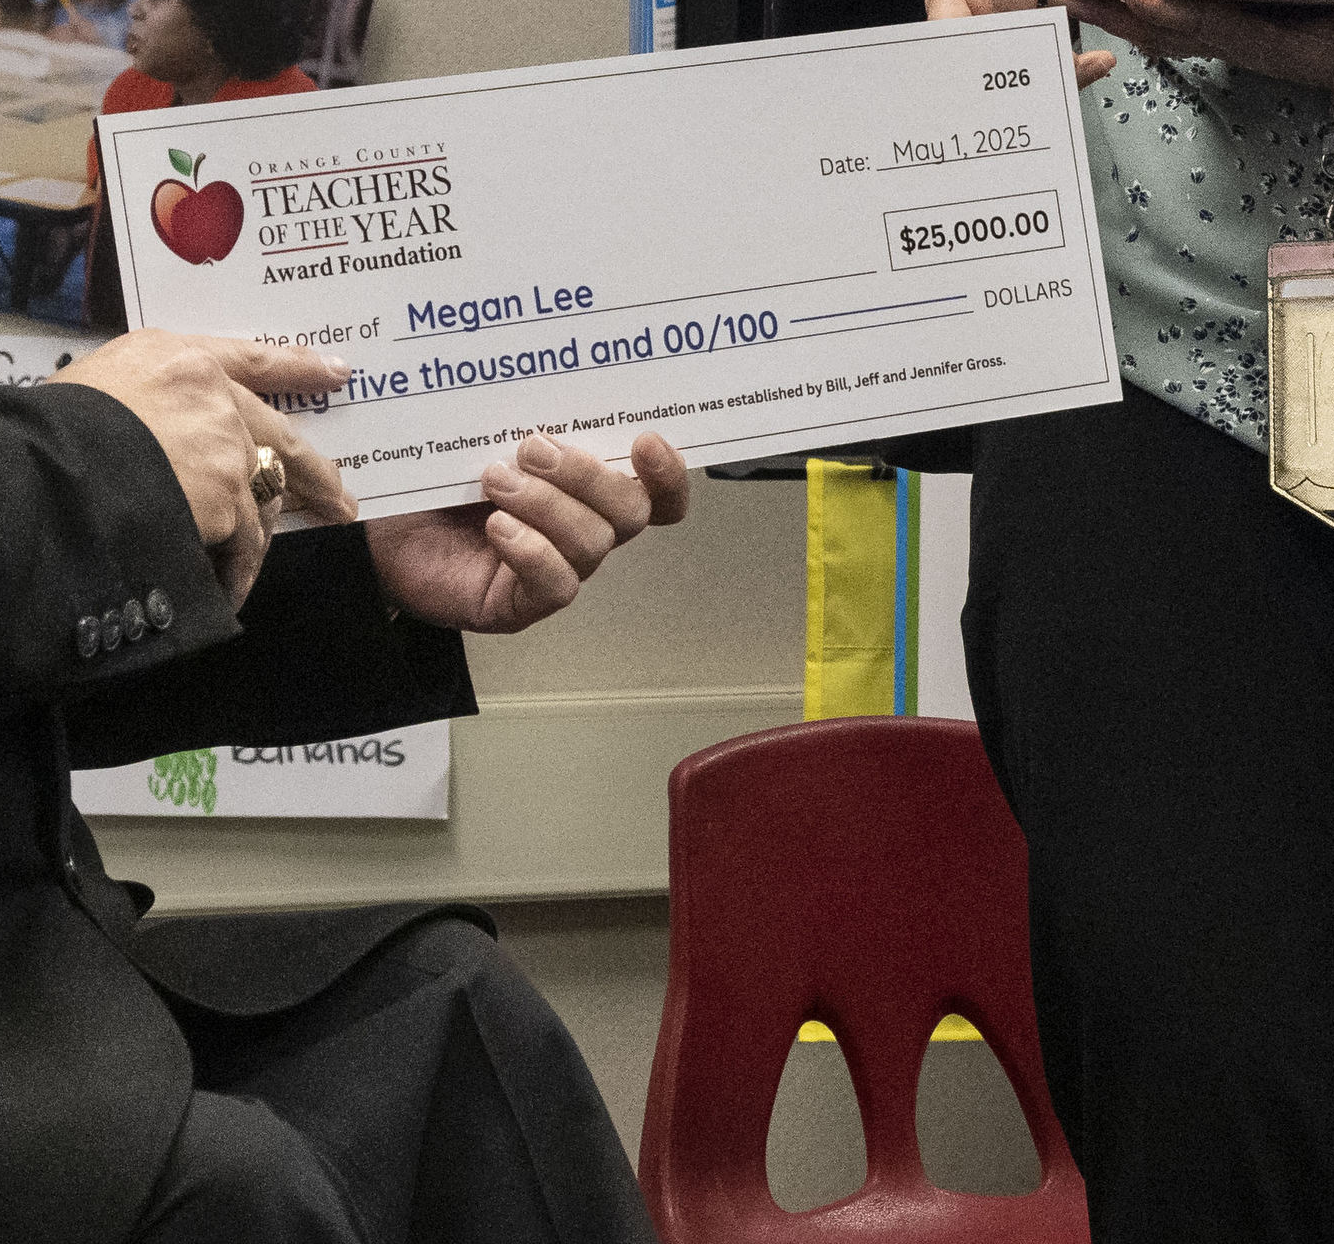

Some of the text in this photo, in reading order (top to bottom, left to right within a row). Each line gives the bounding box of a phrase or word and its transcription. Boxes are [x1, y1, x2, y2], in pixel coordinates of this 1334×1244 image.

[982, 68, 1031, 91] 2026
[820, 124, 1032, 177] Date: May 1, 2025
[252, 165, 452, 218] TEACHERS
[258, 202, 458, 247] OF THE YEAR
[898, 209, 1050, 255] $25,000.00
[262, 243, 463, 285] Award Foundation
[297, 324, 353, 347] order
[360, 317, 380, 339] of
[407, 291, 523, 336] Megan
[534, 283, 594, 316] Lee
[419, 338, 580, 390] thousand
[590, 327, 654, 366] and
[663, 309, 779, 354] 00/100
[983, 278, 1073, 309] DOLLARS
[332, 452, 369, 469] ange
[372, 441, 424, 468] County
[425, 430, 491, 455] Teachers
[493, 426, 509, 445] of
[571, 409, 615, 432] Award
[617, 397, 696, 425] Foundation
[698, 396, 725, 415] was
[727, 382, 804, 409] established
[806, 380, 824, 400] by
[825, 373, 852, 394] Bill,
[854, 368, 881, 390] Jeff
[882, 365, 908, 384] and
[909, 357, 964, 380] Jennifer
[966, 352, 1007, 372] Gross.
